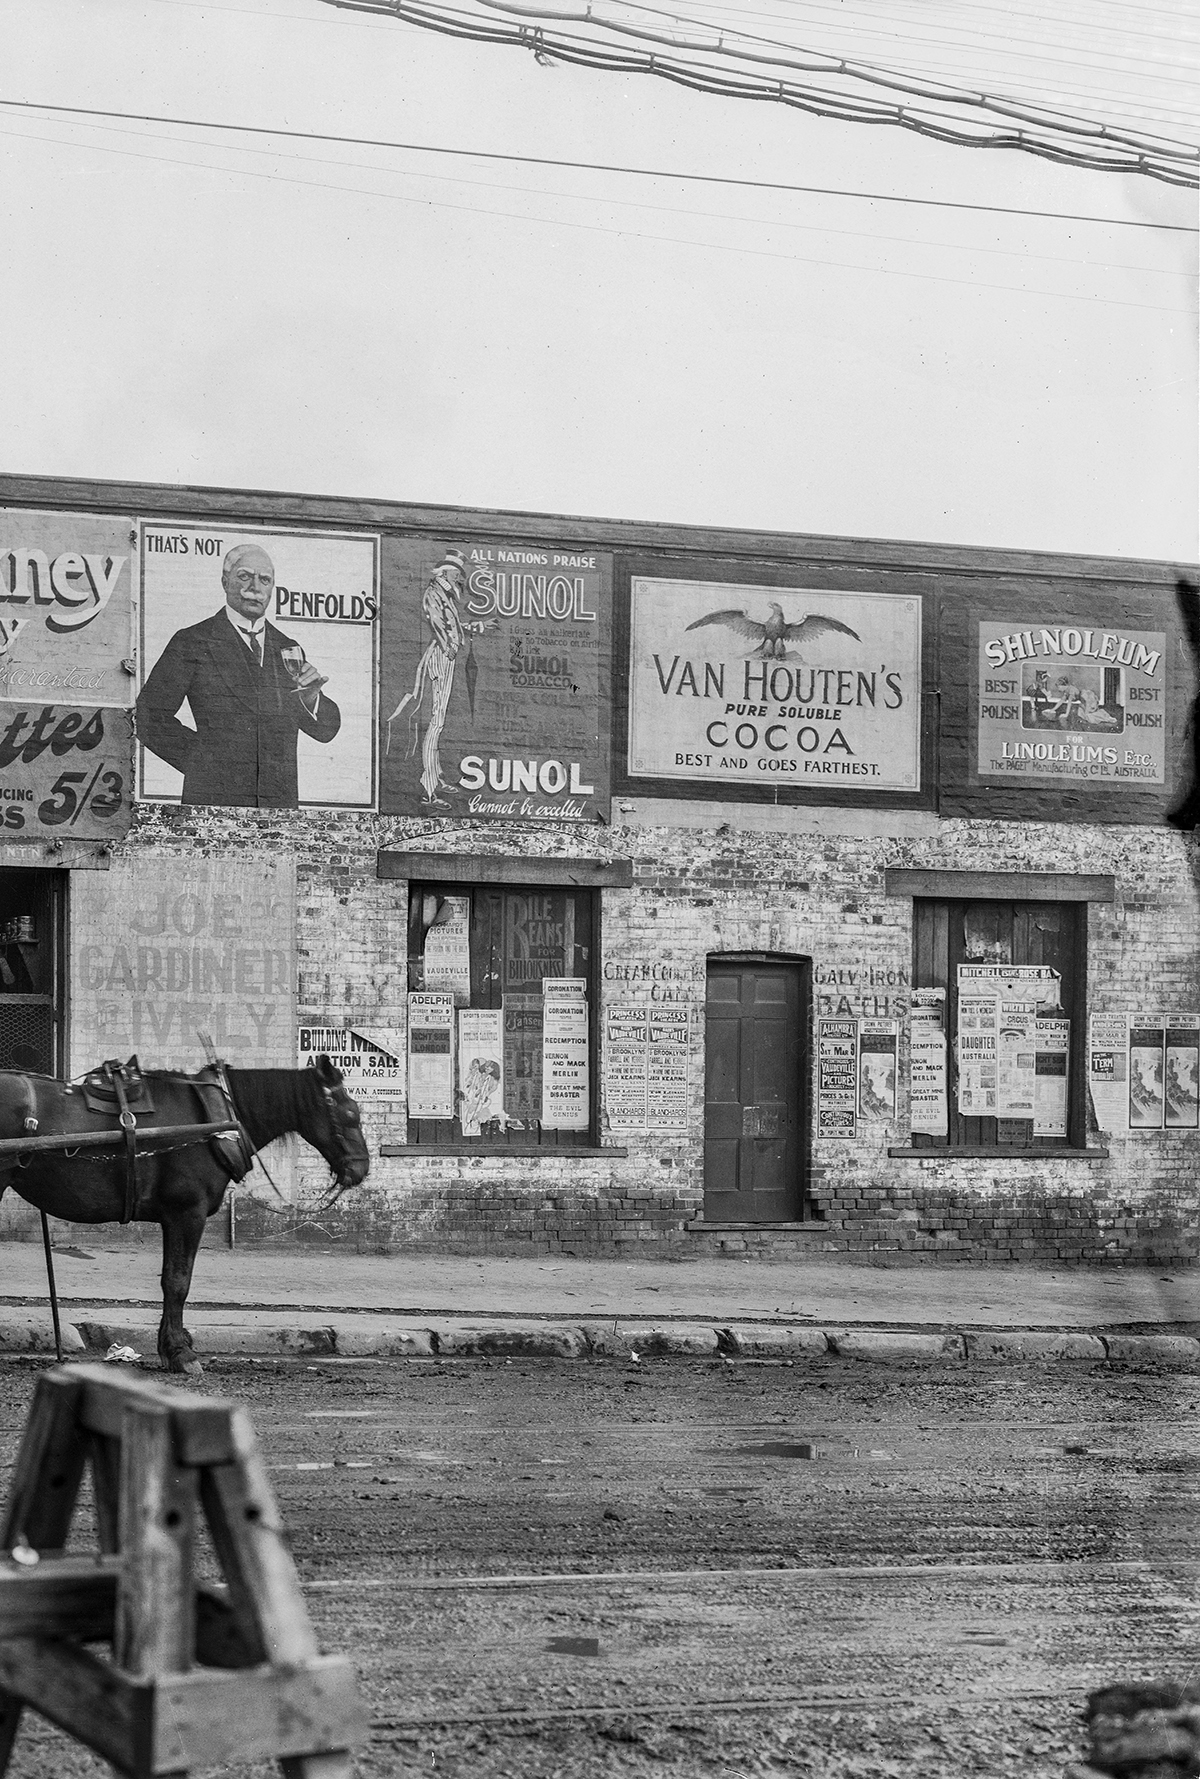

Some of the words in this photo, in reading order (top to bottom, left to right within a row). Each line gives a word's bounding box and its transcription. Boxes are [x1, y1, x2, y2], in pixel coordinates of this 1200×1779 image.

[146, 534, 189, 555] THAT'S
[195, 538, 223, 557] NOT
[471, 549, 495, 562] ALL
[497, 551, 548, 566] NATIONS
[553, 556, 596, 569] PRAISE
[467, 568, 597, 621] SUNOL
[275, 585, 378, 621] PENFOLD'S
[984, 628, 1161, 677] SHI-NOLEUM
[509, 654, 574, 677] SUNOL
[509, 674, 572, 688] TOBACCO
[652, 654, 725, 699] VAN
[742, 660, 904, 710] HOUTEN'S
[984, 679, 1019, 693] BEST
[1129, 688, 1161, 702] BEST
[724, 703, 768, 718] PURE
[777, 706, 842, 721] SOLUBLE
[981, 705, 1019, 720] POLISH
[1125, 713, 1162, 728] POLISH
[706, 720, 856, 756] COCOA
[1066, 735, 1084, 744] FOR
[1002, 741, 1118, 765] LINOLEUMS
[675, 752, 713, 767] BEST
[719, 756, 748, 769] AND
[757, 758, 797, 772] GOES
[804, 760, 881, 776] FARTHEST.
[990, 760, 1004, 771] The
[1032, 762, 1088, 778] Manufacturing
[459, 755, 595, 795] SUNOL
[38, 763, 124, 827] 5/3
[469, 794, 515, 815] Cannot
[519, 796, 533, 815] be
[535, 800, 587, 819] excelled
[130, 893, 243, 938] JOE
[430, 927, 463, 935] PICTURES
[537, 948, 556, 956] FOR
[80, 945, 288, 995] GARDINER
[869, 966, 910, 985] IRON
[961, 967, 1001, 978] MITCHELL
[1018, 968, 1039, 979] ROSE
[547, 985, 583, 993] CORONATION
[410, 995, 451, 1006] ADELPHI
[817, 994, 908, 1018] BATHS
[548, 1007, 584, 1015] CORONATION
[610, 1010, 646, 1021] PRINCESS
[652, 1011, 687, 1022] PRINCESS
[821, 1022, 854, 1037] ALHAMBRA
[300, 1029, 347, 1052] BUILDING
[962, 1036, 996, 1050] DAUGHTER
[306, 1055, 360, 1068] ATION
[368, 1055, 400, 1068] SALE
[545, 1053, 569, 1061] VERNON
[1093, 1057, 1114, 1069] TERM
[362, 1068, 385, 1078] MAR
[821, 1074, 855, 1088] PICTURES
